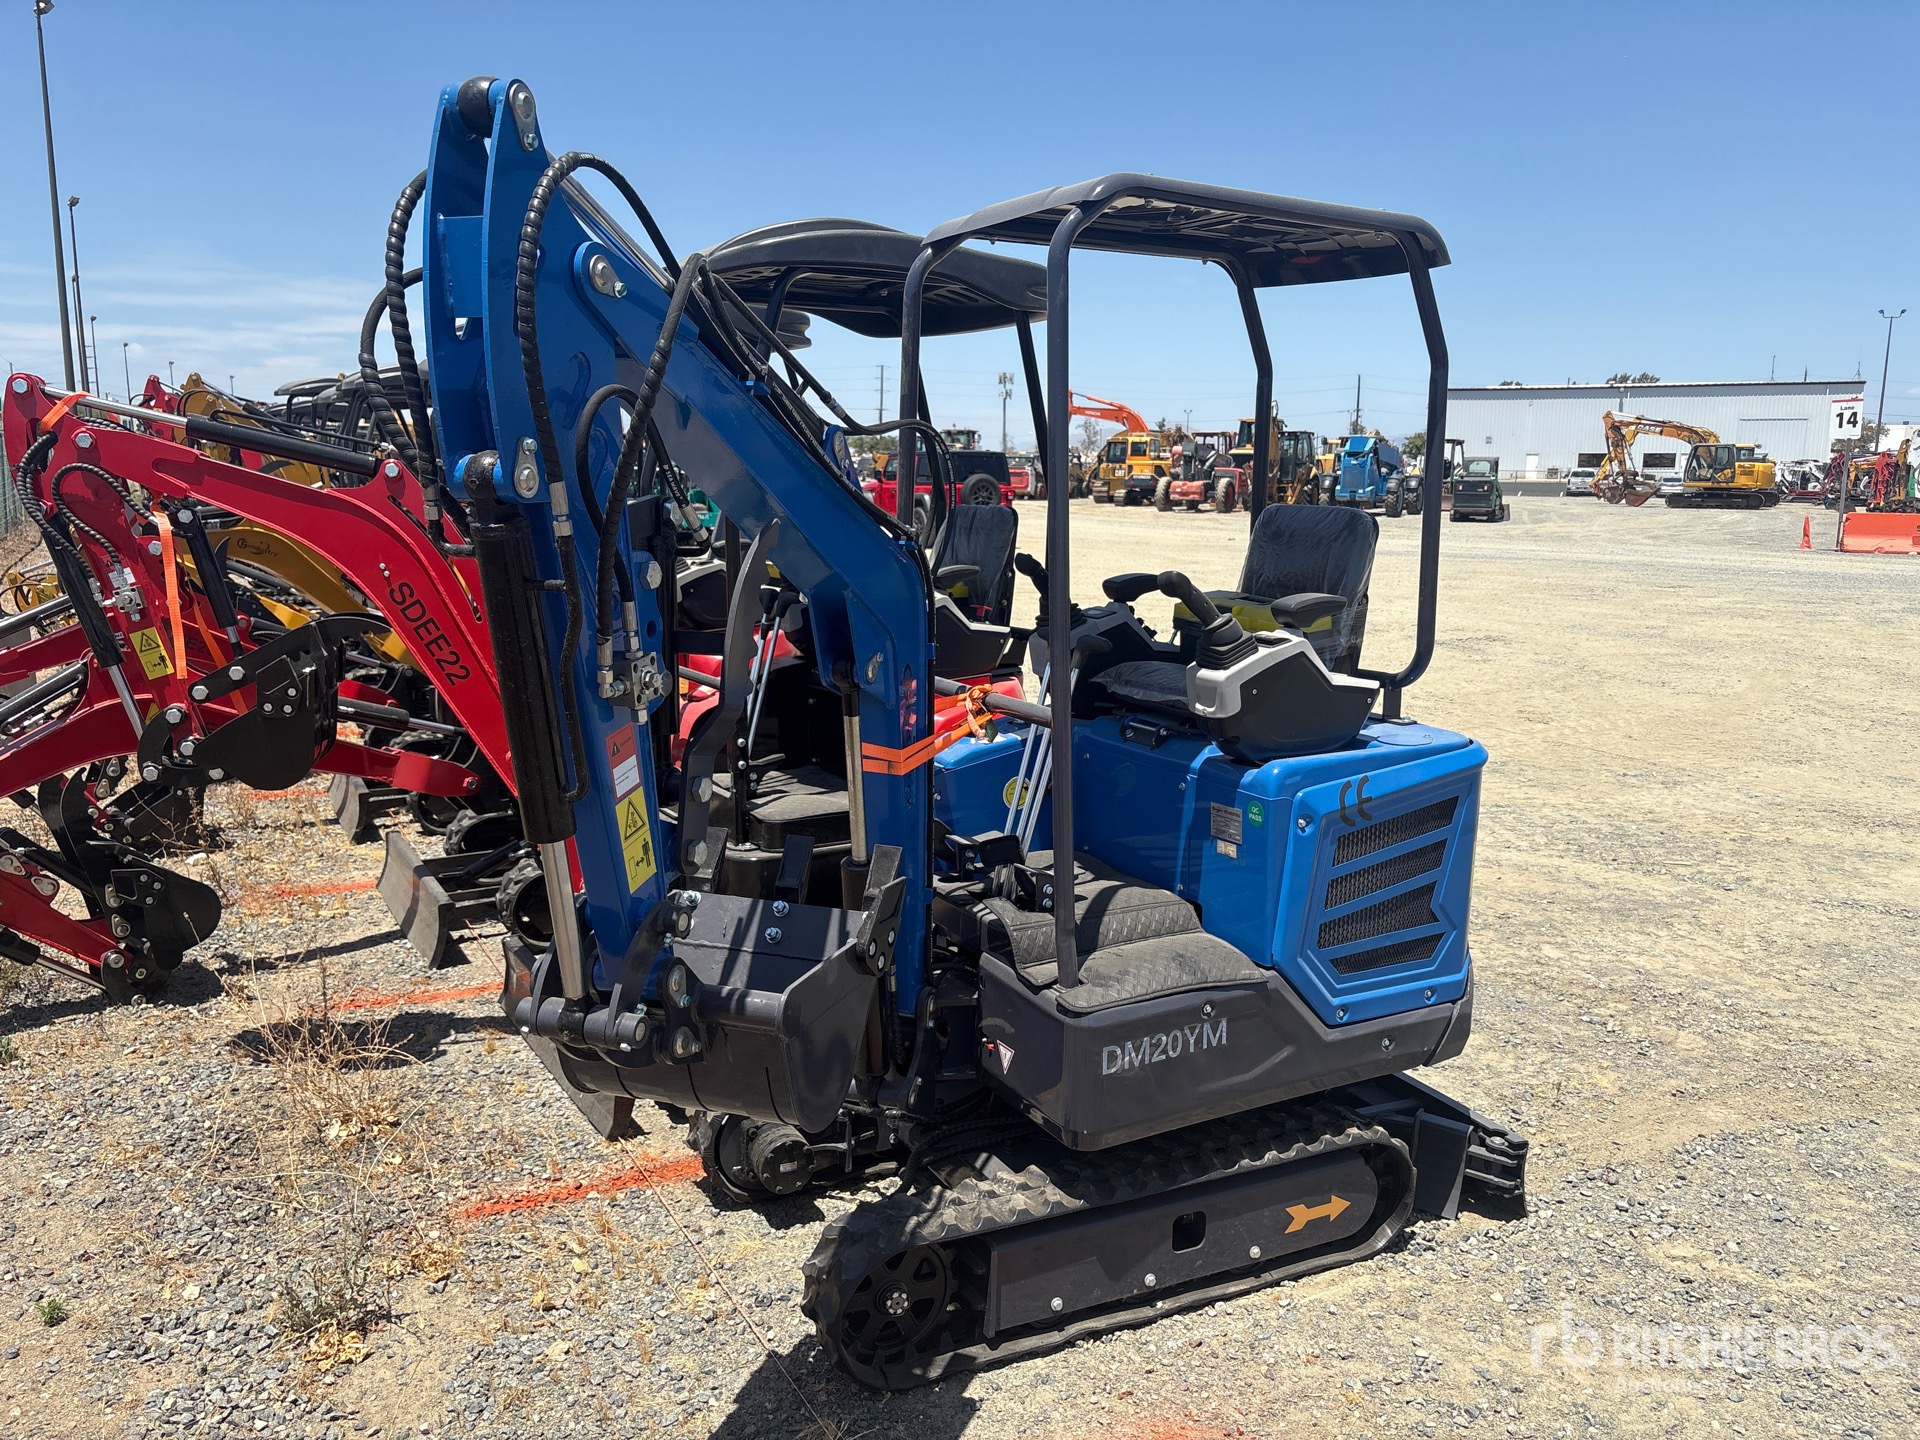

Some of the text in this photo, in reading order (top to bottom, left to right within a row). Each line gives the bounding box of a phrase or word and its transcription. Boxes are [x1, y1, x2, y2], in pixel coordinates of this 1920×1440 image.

[1637, 424, 1662, 433] CASE
[1836, 411, 1858, 429] 14
[389, 581, 471, 687] SDEE22
[1339, 774, 1373, 827] CE
[1248, 812, 1263, 822] PASS
[1251, 806, 1260, 814] QC
[1101, 1017, 1228, 1076] DM20YM
